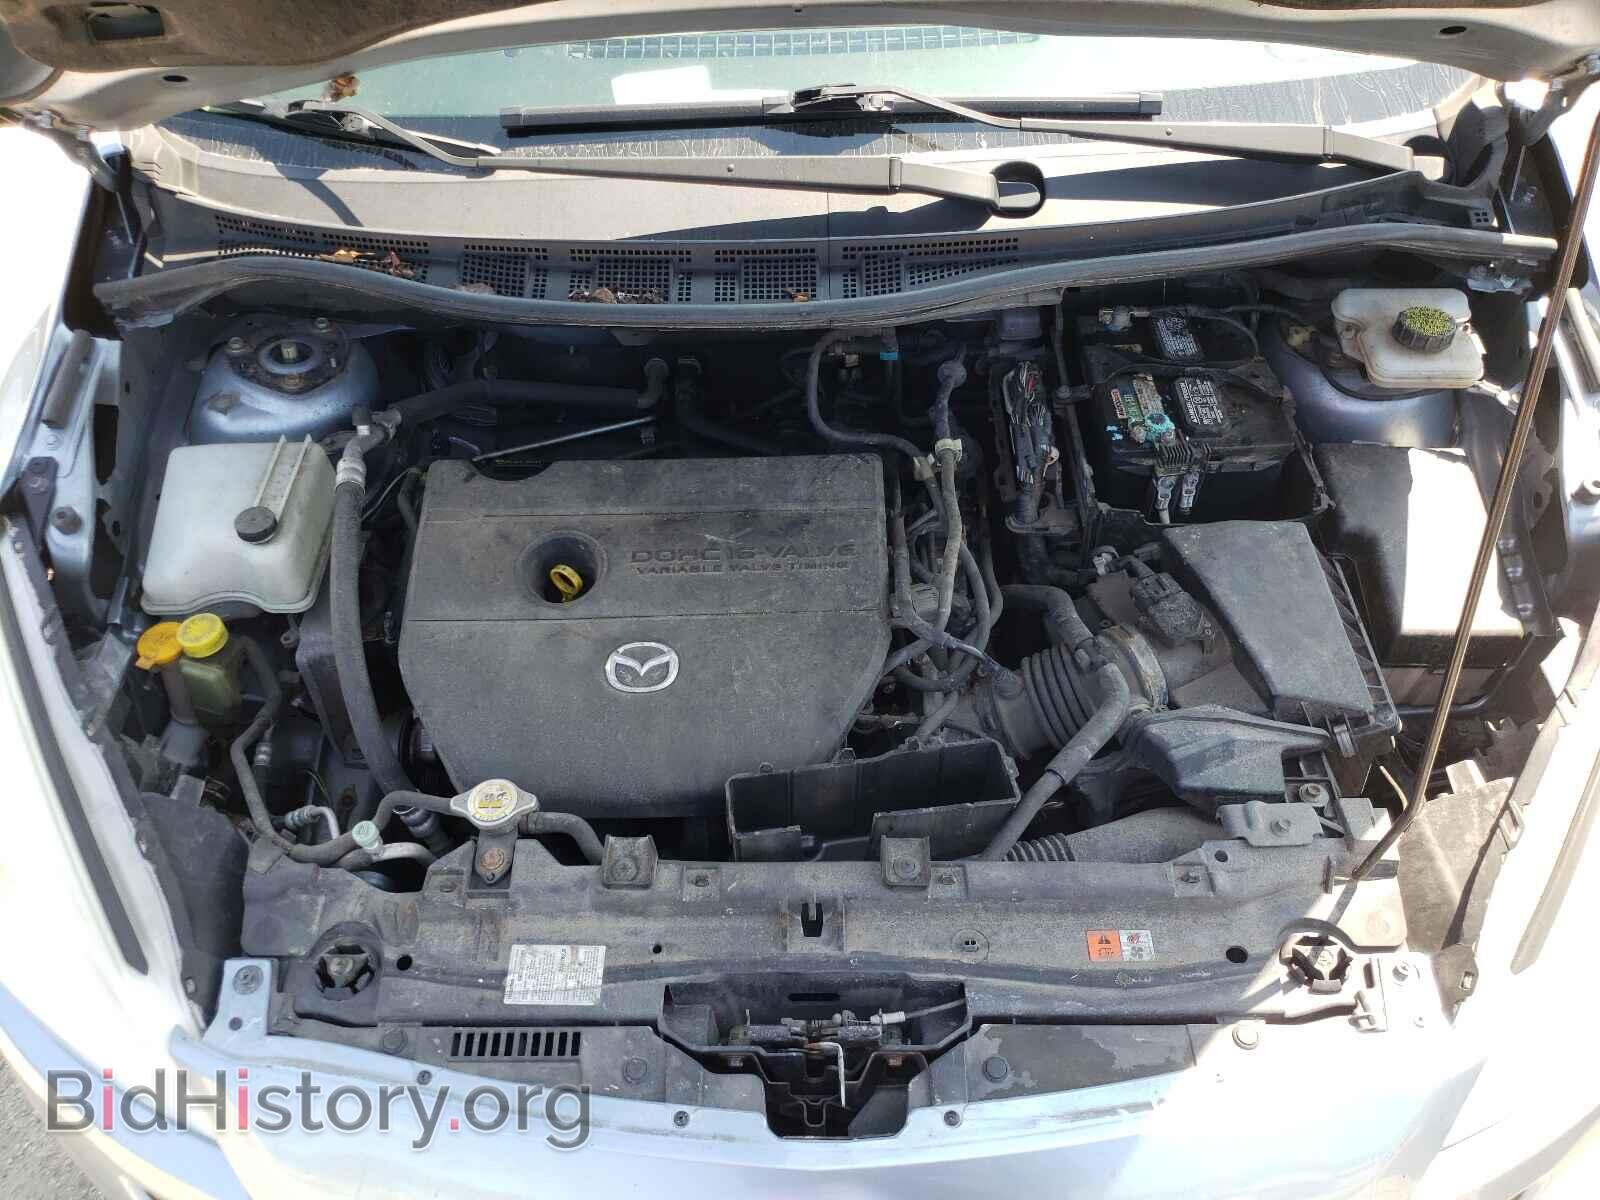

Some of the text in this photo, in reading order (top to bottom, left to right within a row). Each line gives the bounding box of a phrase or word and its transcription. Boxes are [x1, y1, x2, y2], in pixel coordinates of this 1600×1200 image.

[631, 549, 721, 562] DOHC
[633, 559, 849, 576] VARIABLE VALVE TIMING
